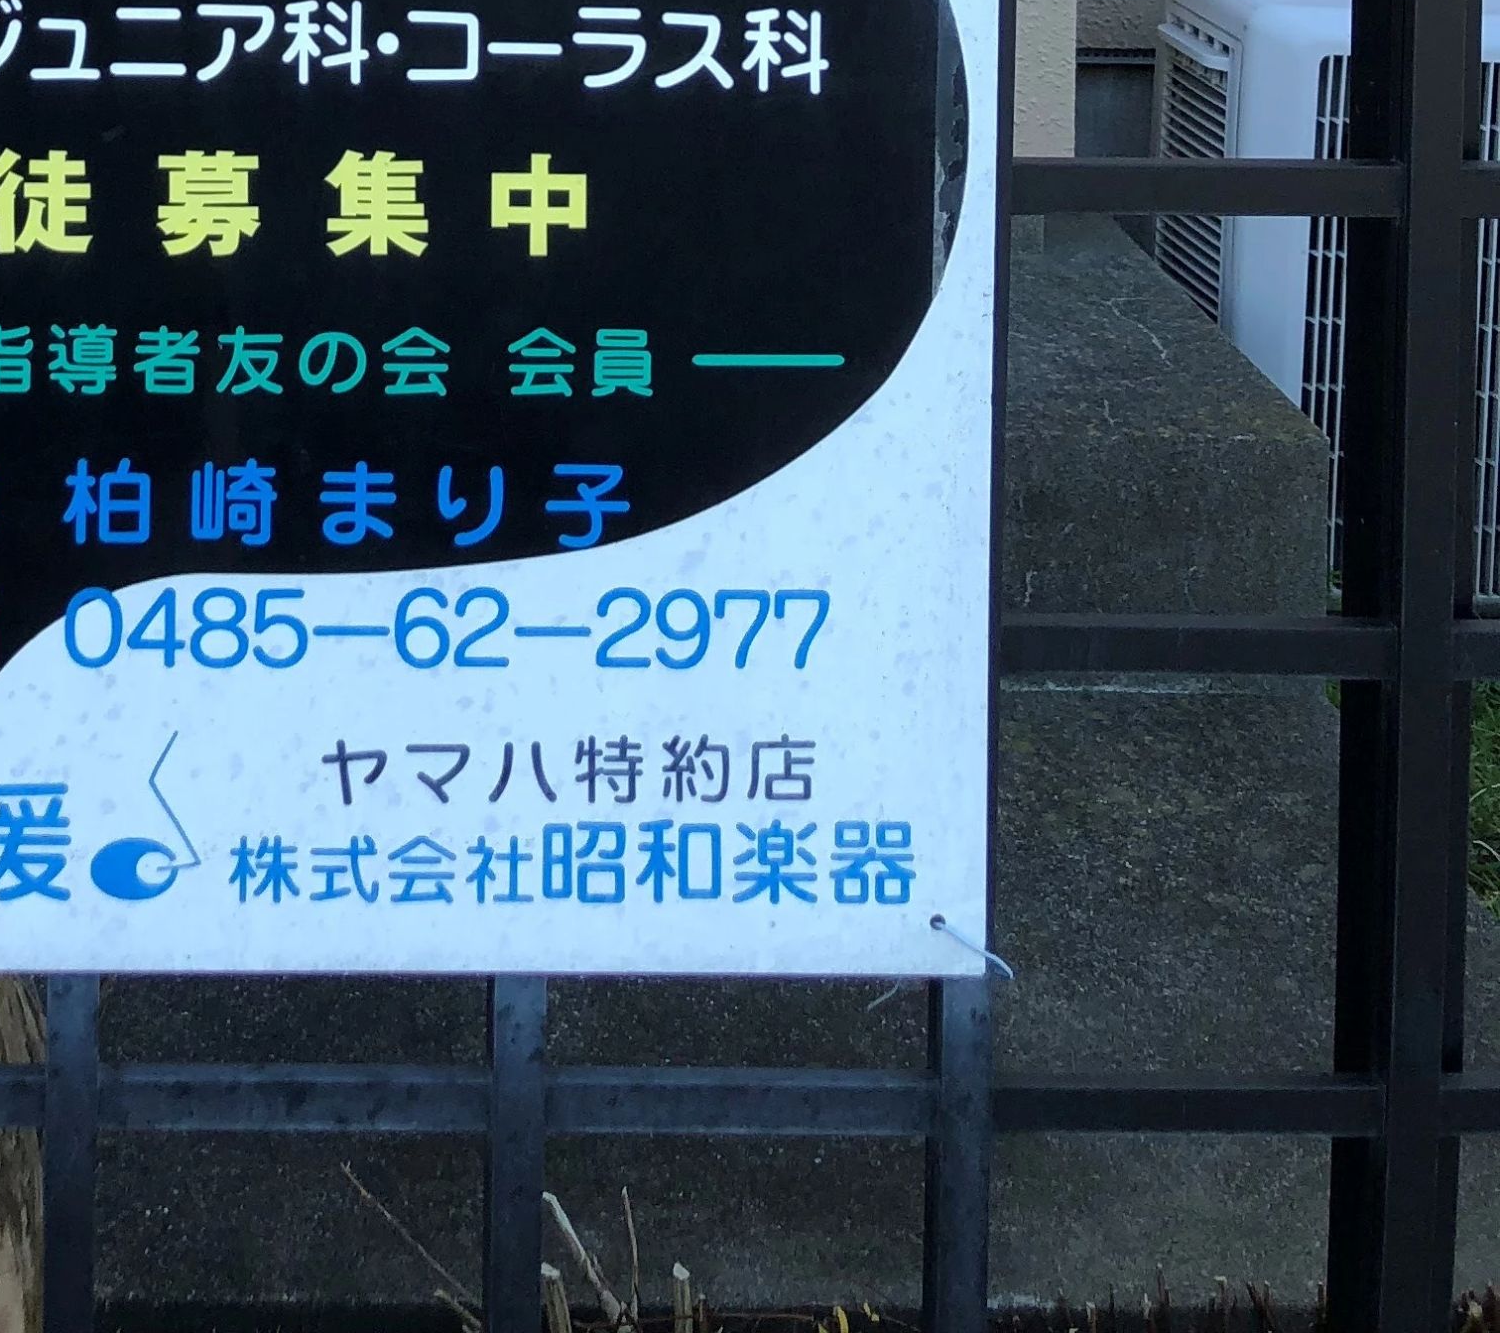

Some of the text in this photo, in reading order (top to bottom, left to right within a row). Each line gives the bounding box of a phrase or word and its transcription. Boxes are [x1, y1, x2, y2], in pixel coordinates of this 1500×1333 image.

[506, 326, 655, 398] 会員
[61, 456, 632, 554] 柏崎まり子
[321, 735, 817, 806] ヤマハ特約店
[226, 816, 918, 909] 株式会社昭和楽器
